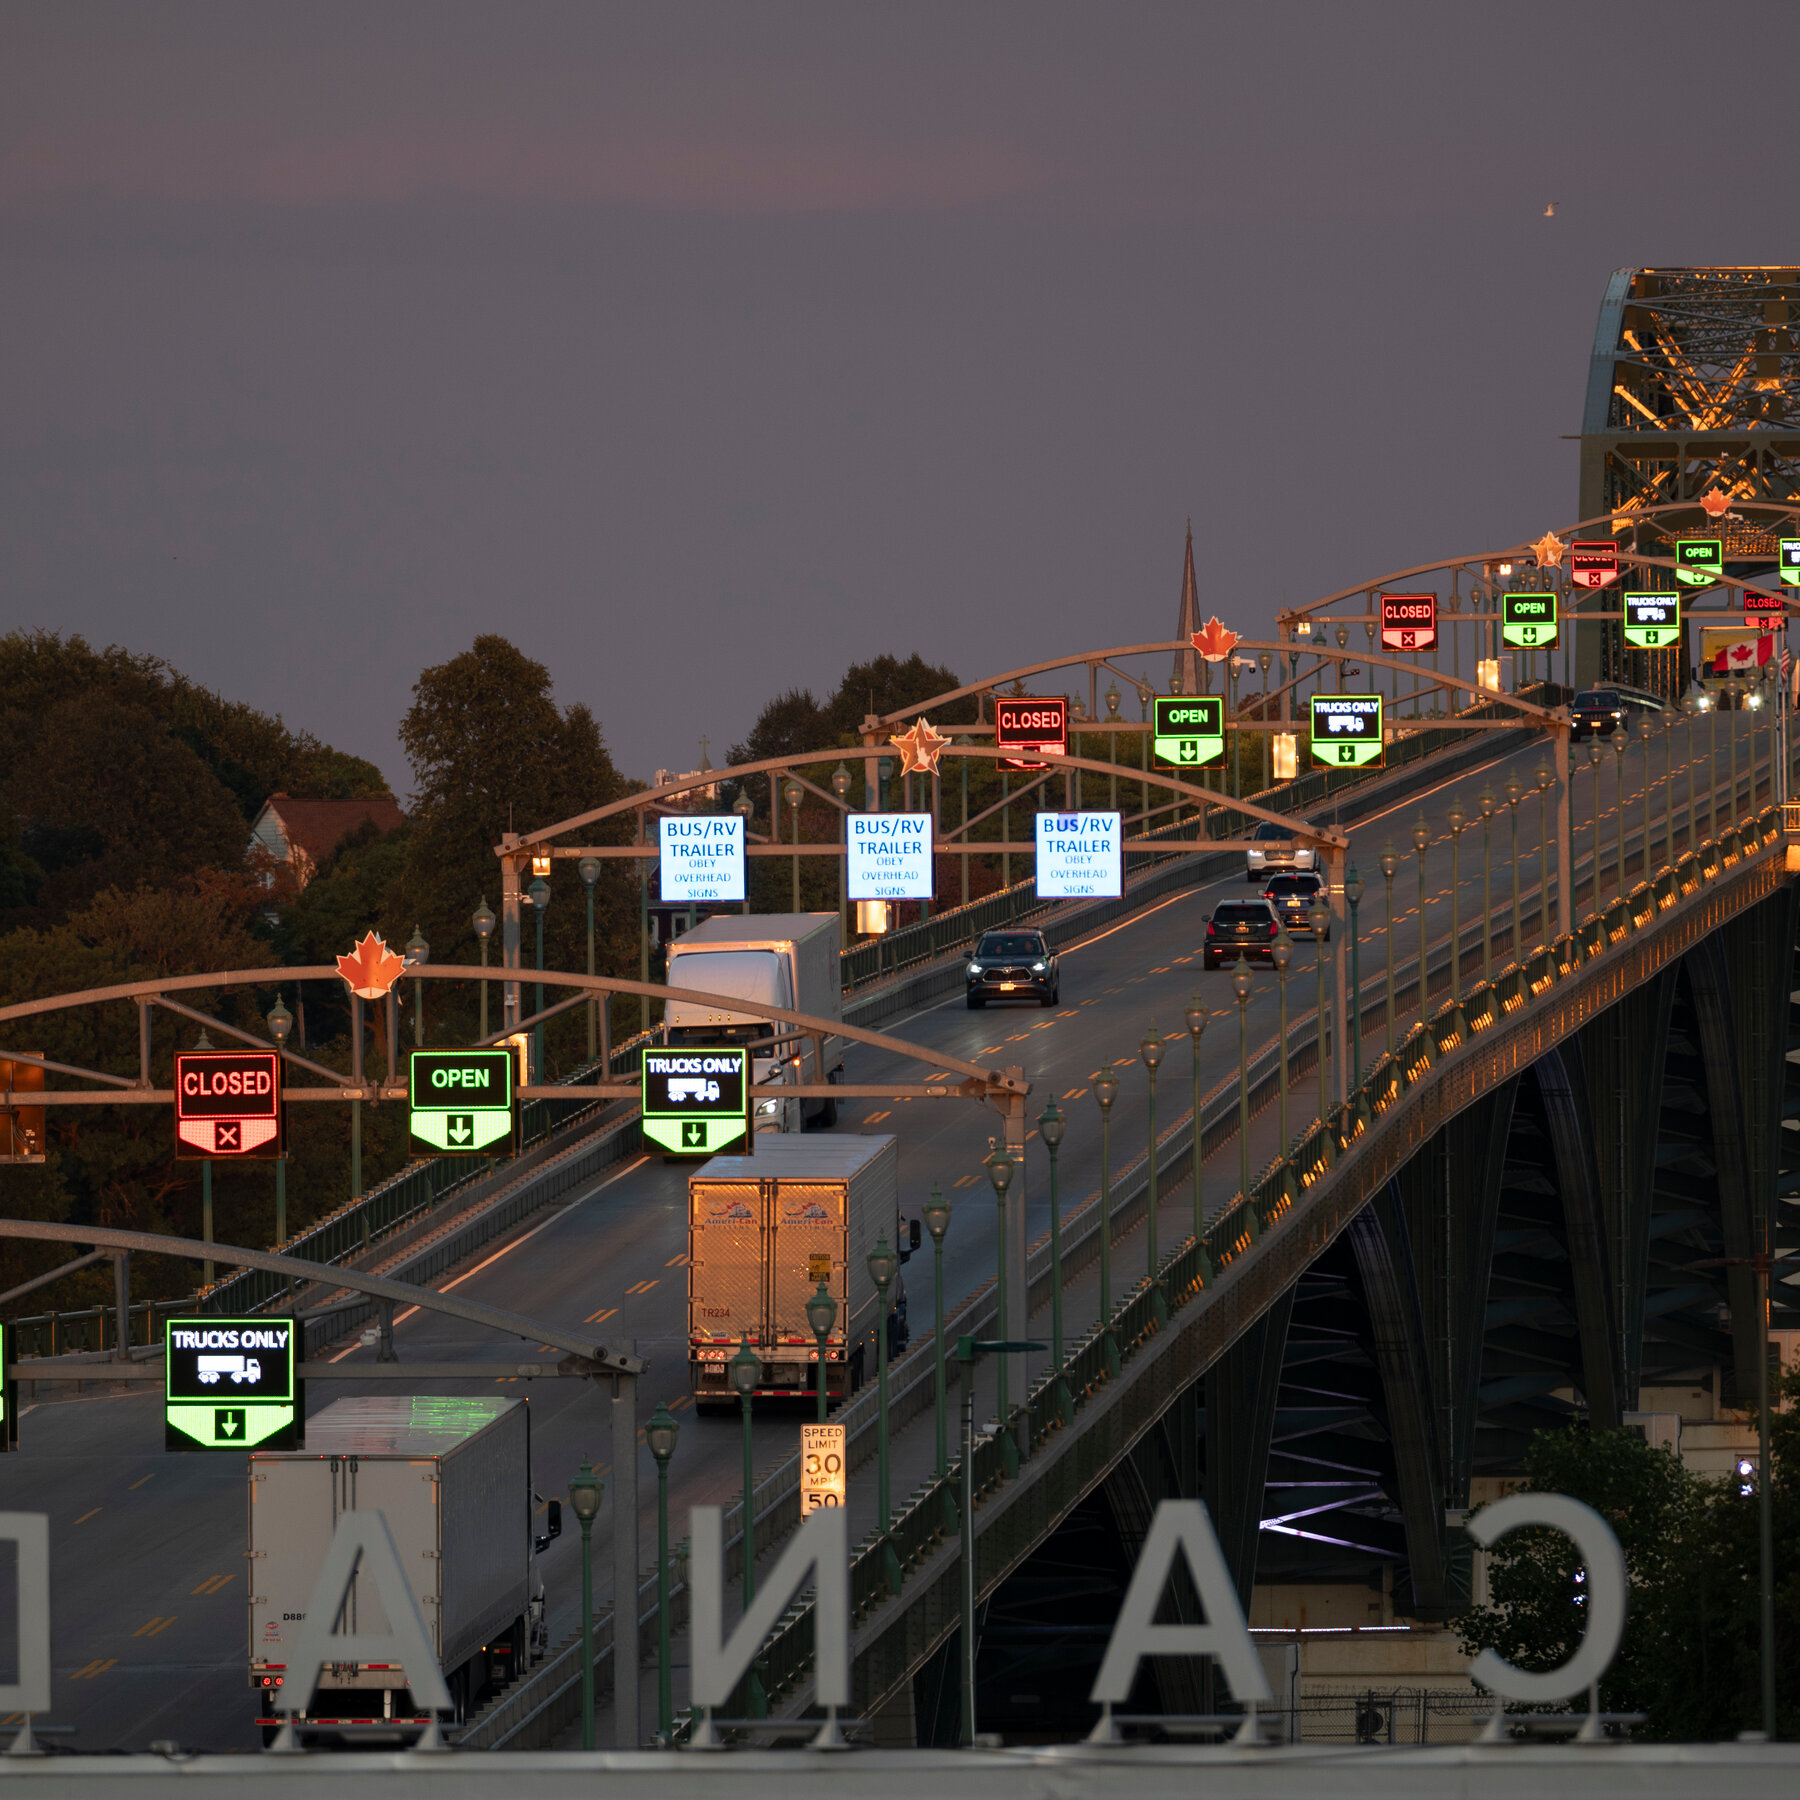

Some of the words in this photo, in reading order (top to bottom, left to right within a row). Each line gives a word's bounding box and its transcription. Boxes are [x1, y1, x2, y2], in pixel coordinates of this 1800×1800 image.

[1685, 547, 1713, 561] OPEN
[1656, 597, 1676, 606] ONLY
[1746, 598, 1780, 608] CLOSED
[1385, 605, 1431, 619] CLOSED
[1514, 602, 1545, 615] OPEN
[1314, 702, 1351, 713] TRUCKS
[1351, 702, 1379, 713] ONLY
[1002, 711, 1061, 730] CLOSED
[1169, 709, 1209, 724] OPEN
[667, 820, 737, 839] BUS/RV
[855, 818, 925, 837] BUS/RV
[1043, 817, 1113, 836] BUS/RV
[670, 844, 735, 857] TRAILER
[858, 842, 923, 855] TRAILER
[1046, 841, 1111, 854] TRAILER
[688, 859, 716, 869] OBEY
[876, 857, 904, 867] OBEY
[1064, 856, 1092, 866] OBEY
[674, 873, 731, 883] OVERHEAD
[862, 871, 919, 881] OVERHEAD
[1050, 870, 1107, 880] OVERHEAD
[687, 889, 719, 898] SIGNS
[875, 887, 907, 896] SIGNS
[1063, 886, 1095, 895] SIGNS
[647, 1057, 702, 1074] TRUCKS
[702, 1057, 742, 1074] ONLY
[184, 1071, 271, 1096] CLOSED
[431, 1068, 490, 1089] OPEN
[702, 1308, 730, 1318] TR234
[171, 1330, 240, 1349] TRUCKS
[240, 1330, 289, 1349] ONLY
[804, 1428, 842, 1437] SPEED
[808, 1440, 838, 1449] LIMIT
[806, 1454, 841, 1475] 30
[808, 1493, 838, 1510] 50
